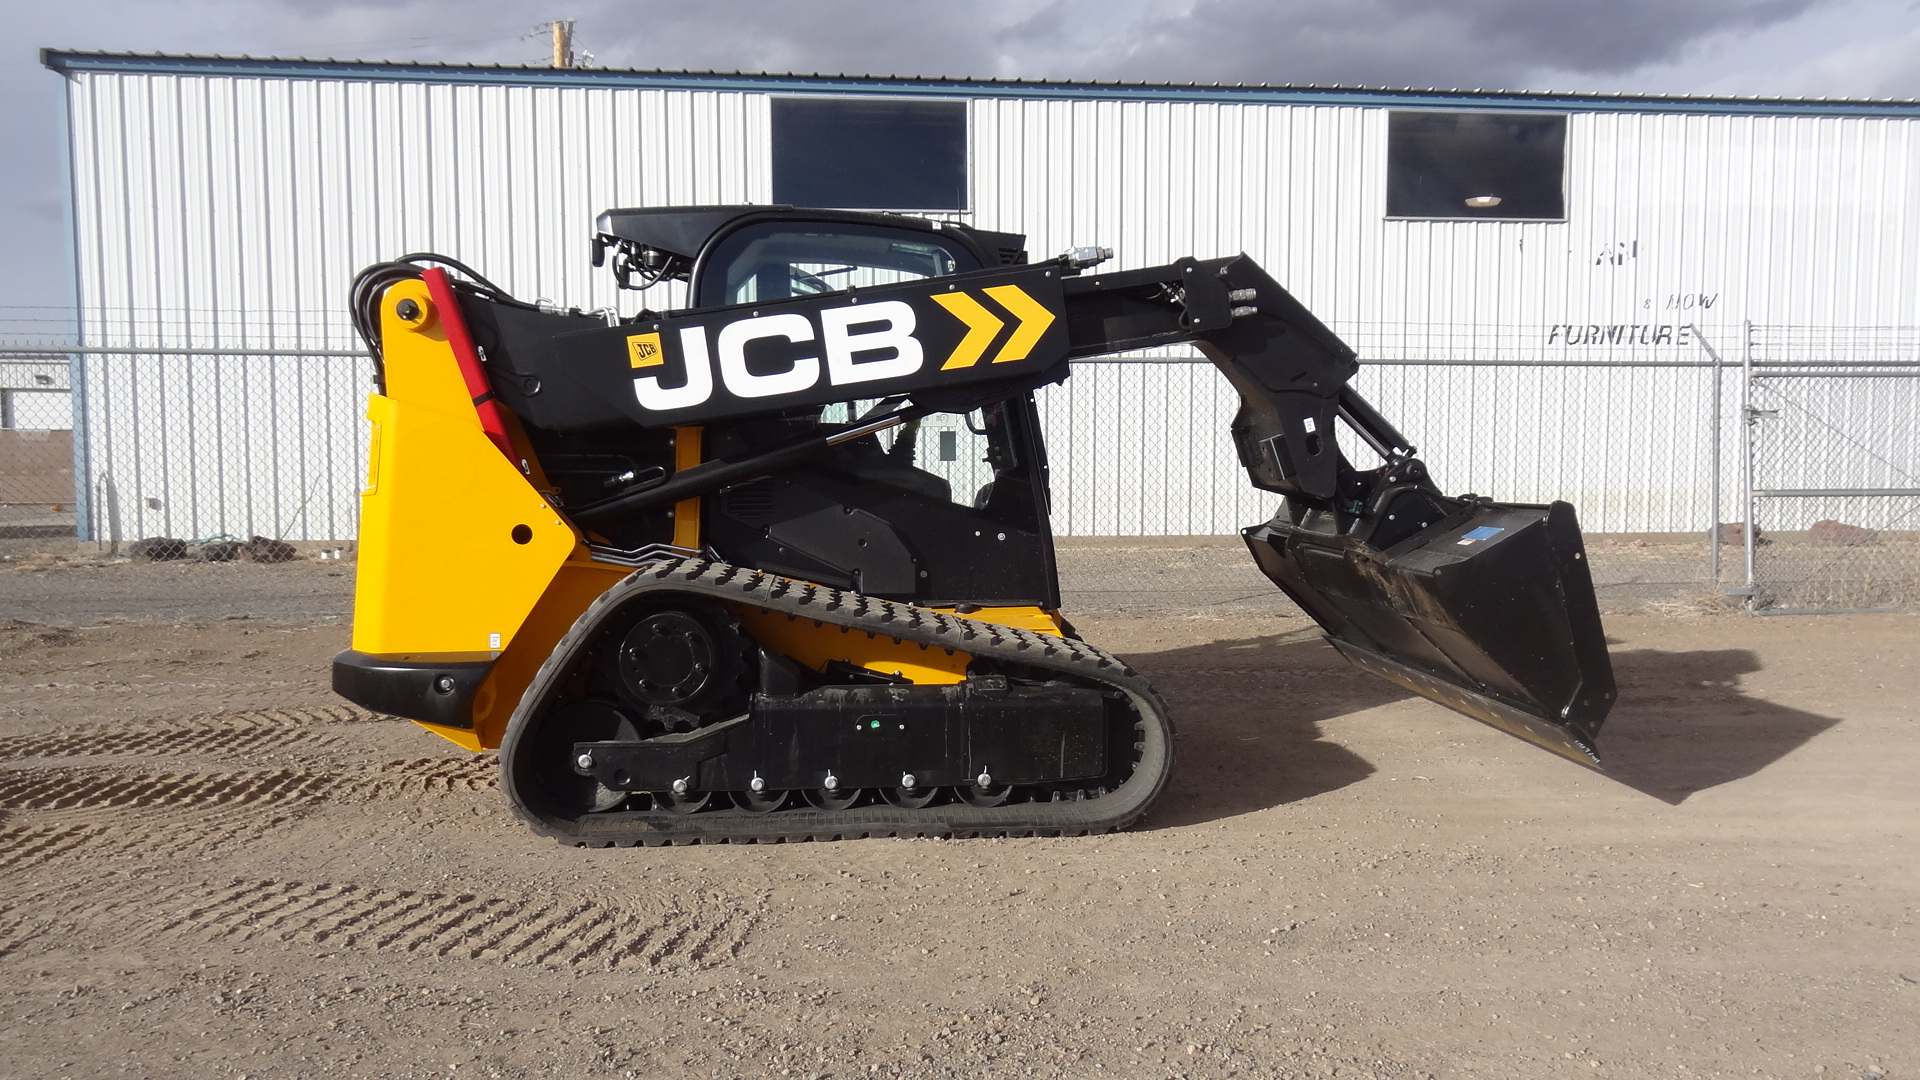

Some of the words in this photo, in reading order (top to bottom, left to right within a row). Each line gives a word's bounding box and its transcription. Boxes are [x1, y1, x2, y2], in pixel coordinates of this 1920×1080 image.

[1548, 324, 1692, 345] FURNITURE
[633, 300, 924, 411] JCB
[636, 343, 657, 358] JCB
